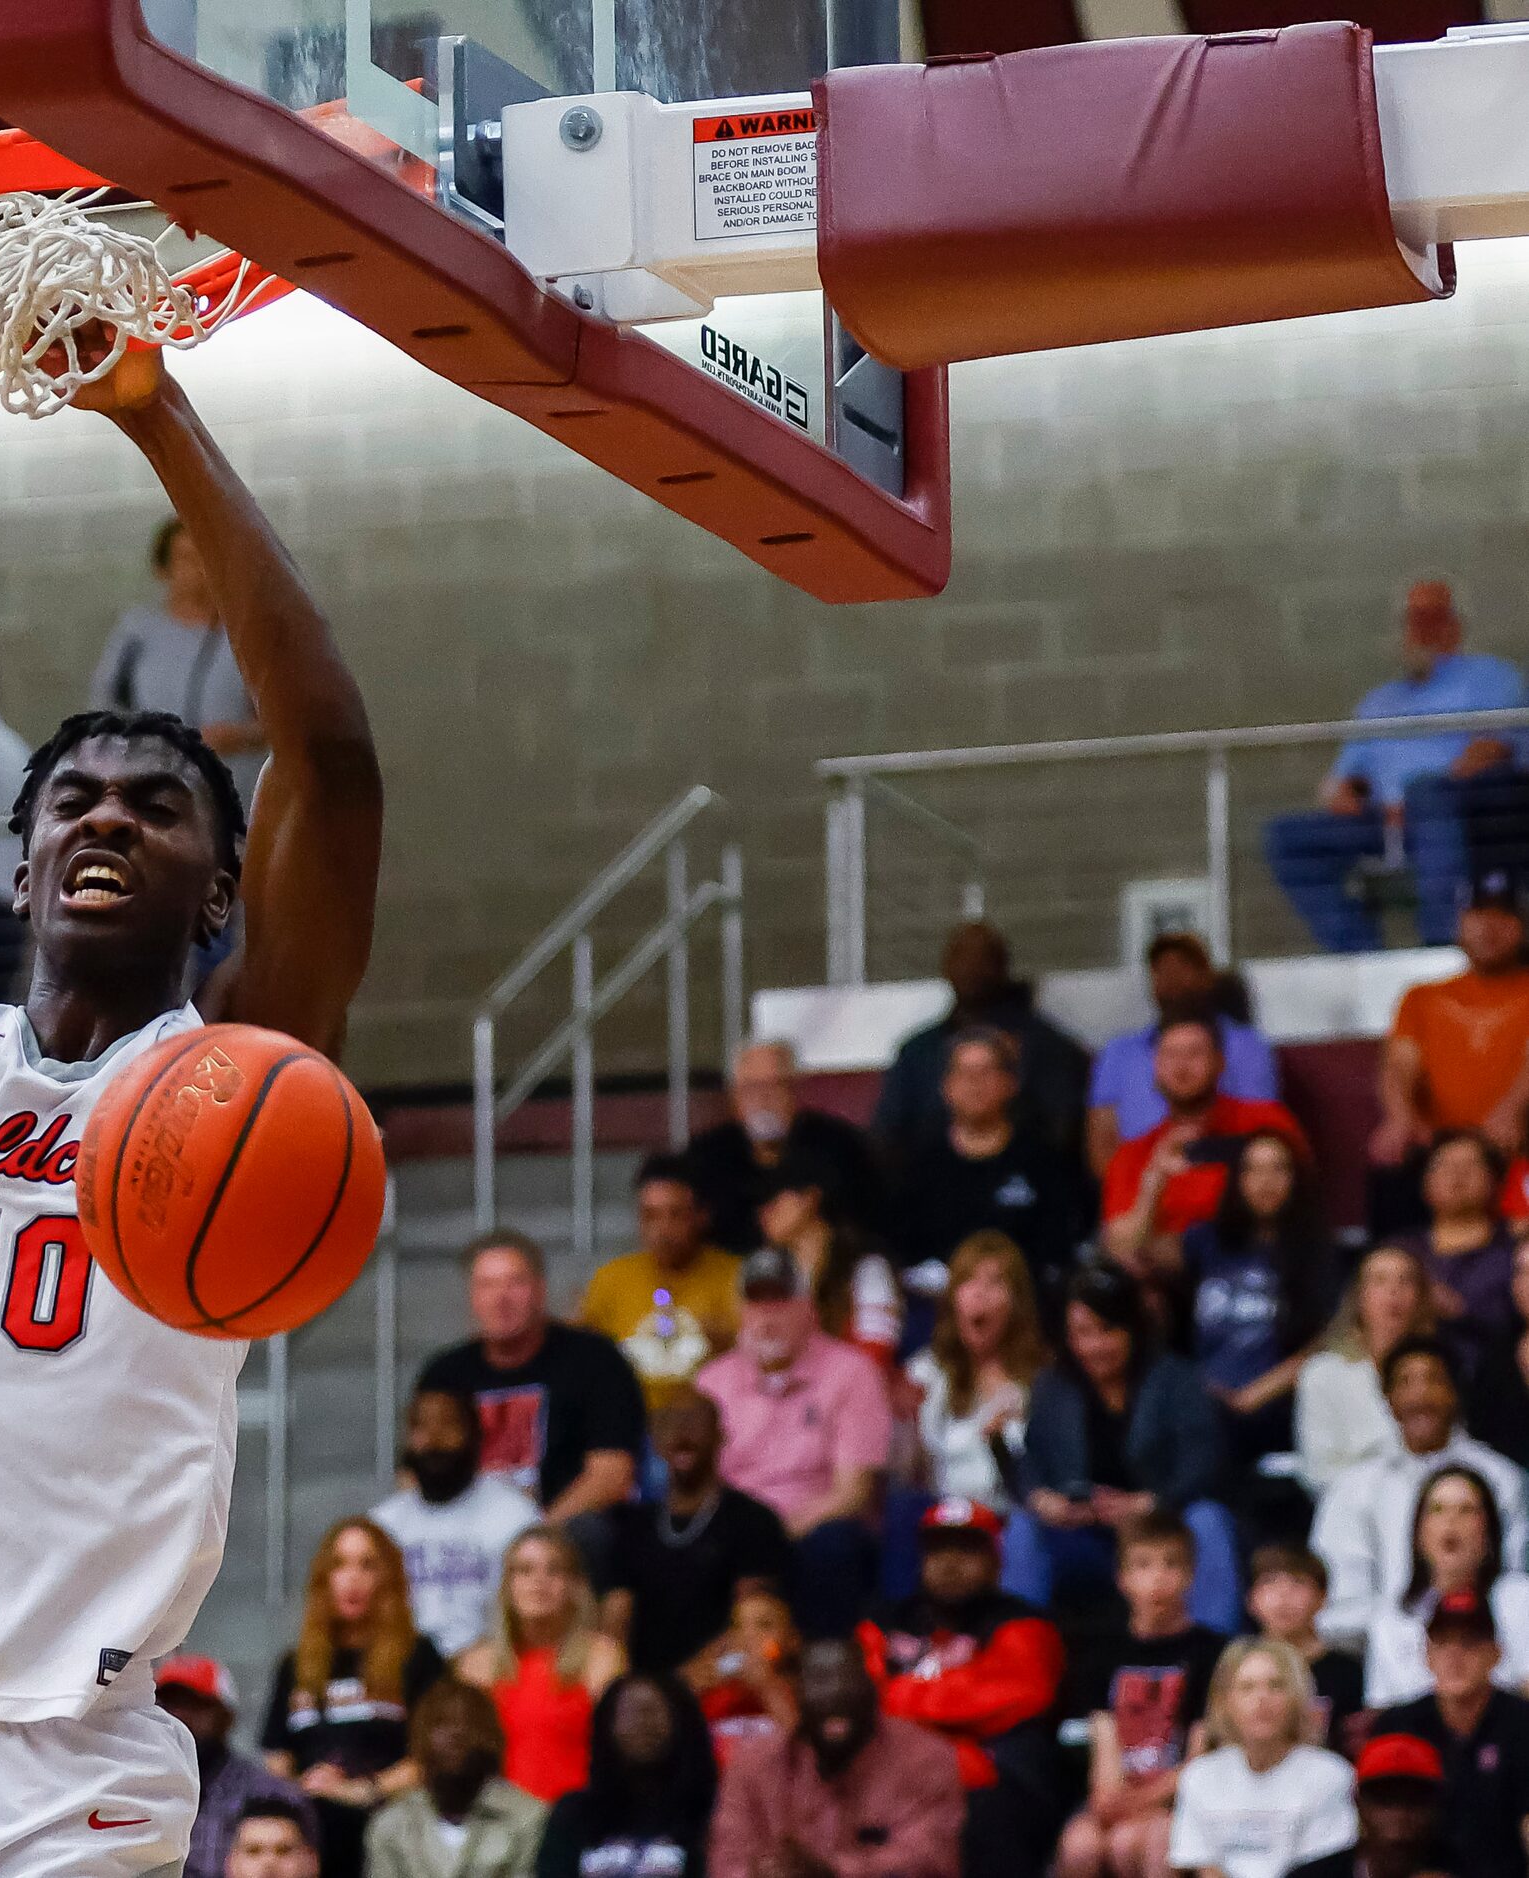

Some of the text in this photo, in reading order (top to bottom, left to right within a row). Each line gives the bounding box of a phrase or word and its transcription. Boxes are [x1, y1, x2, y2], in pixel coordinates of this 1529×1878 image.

[739, 112, 817, 134] WARNI
[712, 141, 817, 159] DO NOT REMOVE BAC
[711, 152, 817, 170] BEFORE INSTALLING S
[699, 172, 731, 183] BRACE
[734, 171, 748, 180] ON
[751, 169, 775, 178] MAIN
[713, 180, 773, 193] BACKBOARD
[714, 188, 817, 205] INSTALLED COULD RE
[717, 201, 814, 217] SERIOUS PERSONAL
[723, 217, 760, 228] AND/OR
[763, 213, 804, 225] DAMAGE
